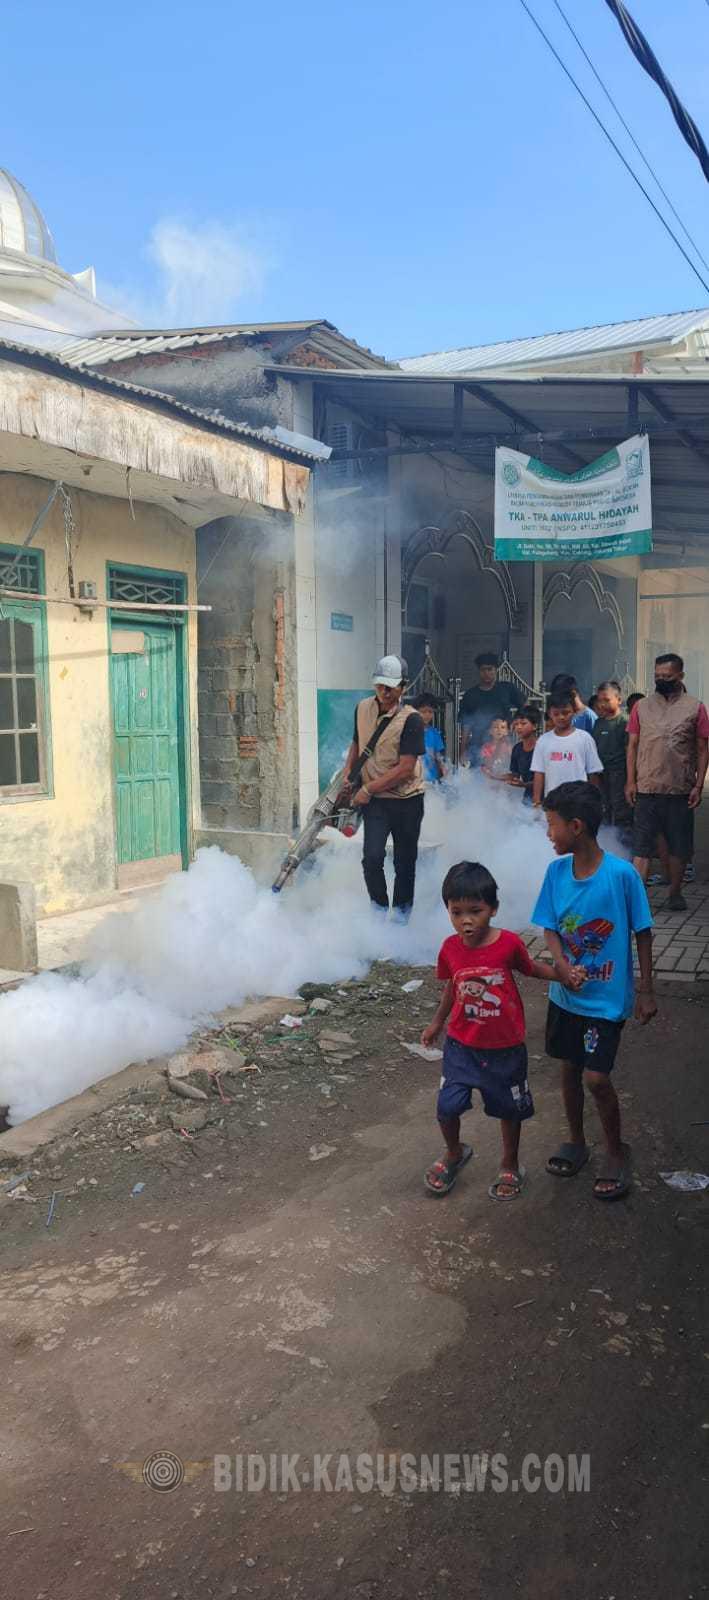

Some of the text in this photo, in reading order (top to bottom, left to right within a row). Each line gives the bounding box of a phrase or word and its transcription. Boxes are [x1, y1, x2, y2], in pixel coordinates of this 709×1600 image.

[508, 511, 526, 521] TKA
[533, 512, 549, 522] TPA
[550, 511, 596, 522] ANWARUL
[598, 504, 639, 520] HIDAYAH
